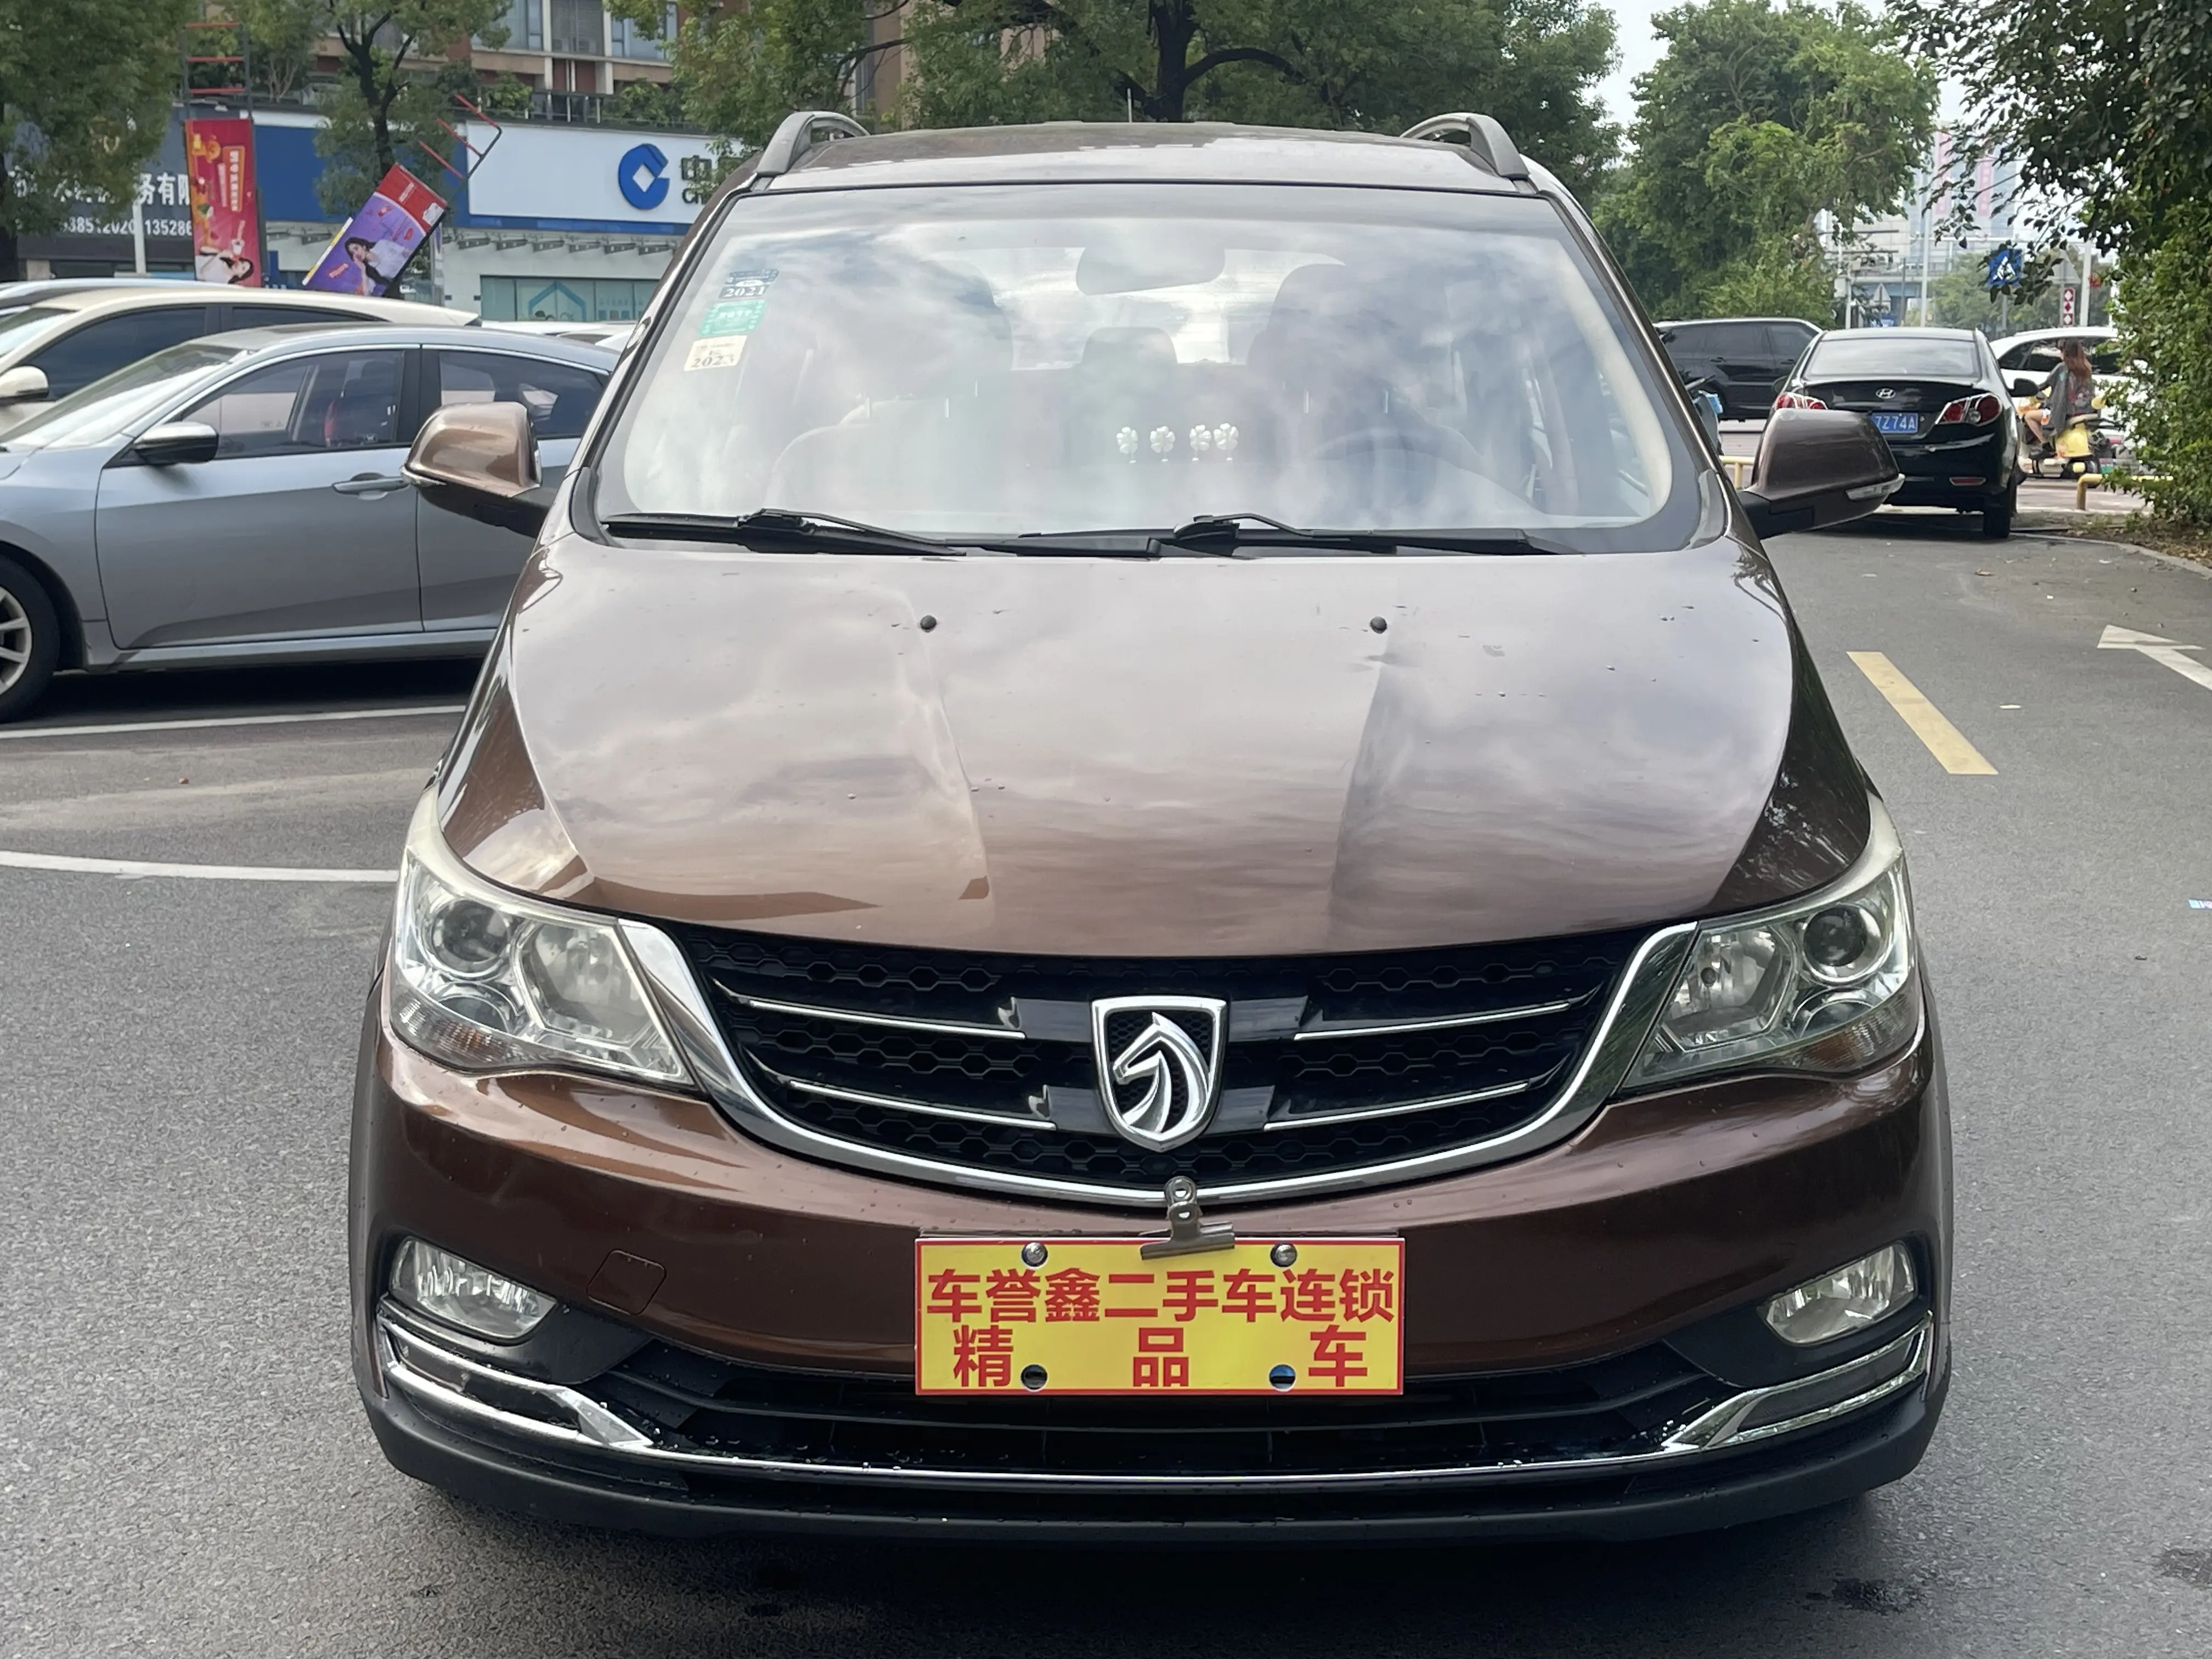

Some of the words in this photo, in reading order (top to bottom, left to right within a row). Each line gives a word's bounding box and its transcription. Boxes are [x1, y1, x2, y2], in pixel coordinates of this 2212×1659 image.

[724, 286, 765, 297] 2021
[927, 1268, 1394, 1323] 车誉鑫二手车连锁
[953, 1325, 1013, 1387] 精
[1133, 1328, 1189, 1387] 品
[1308, 1325, 1368, 1387] 车
